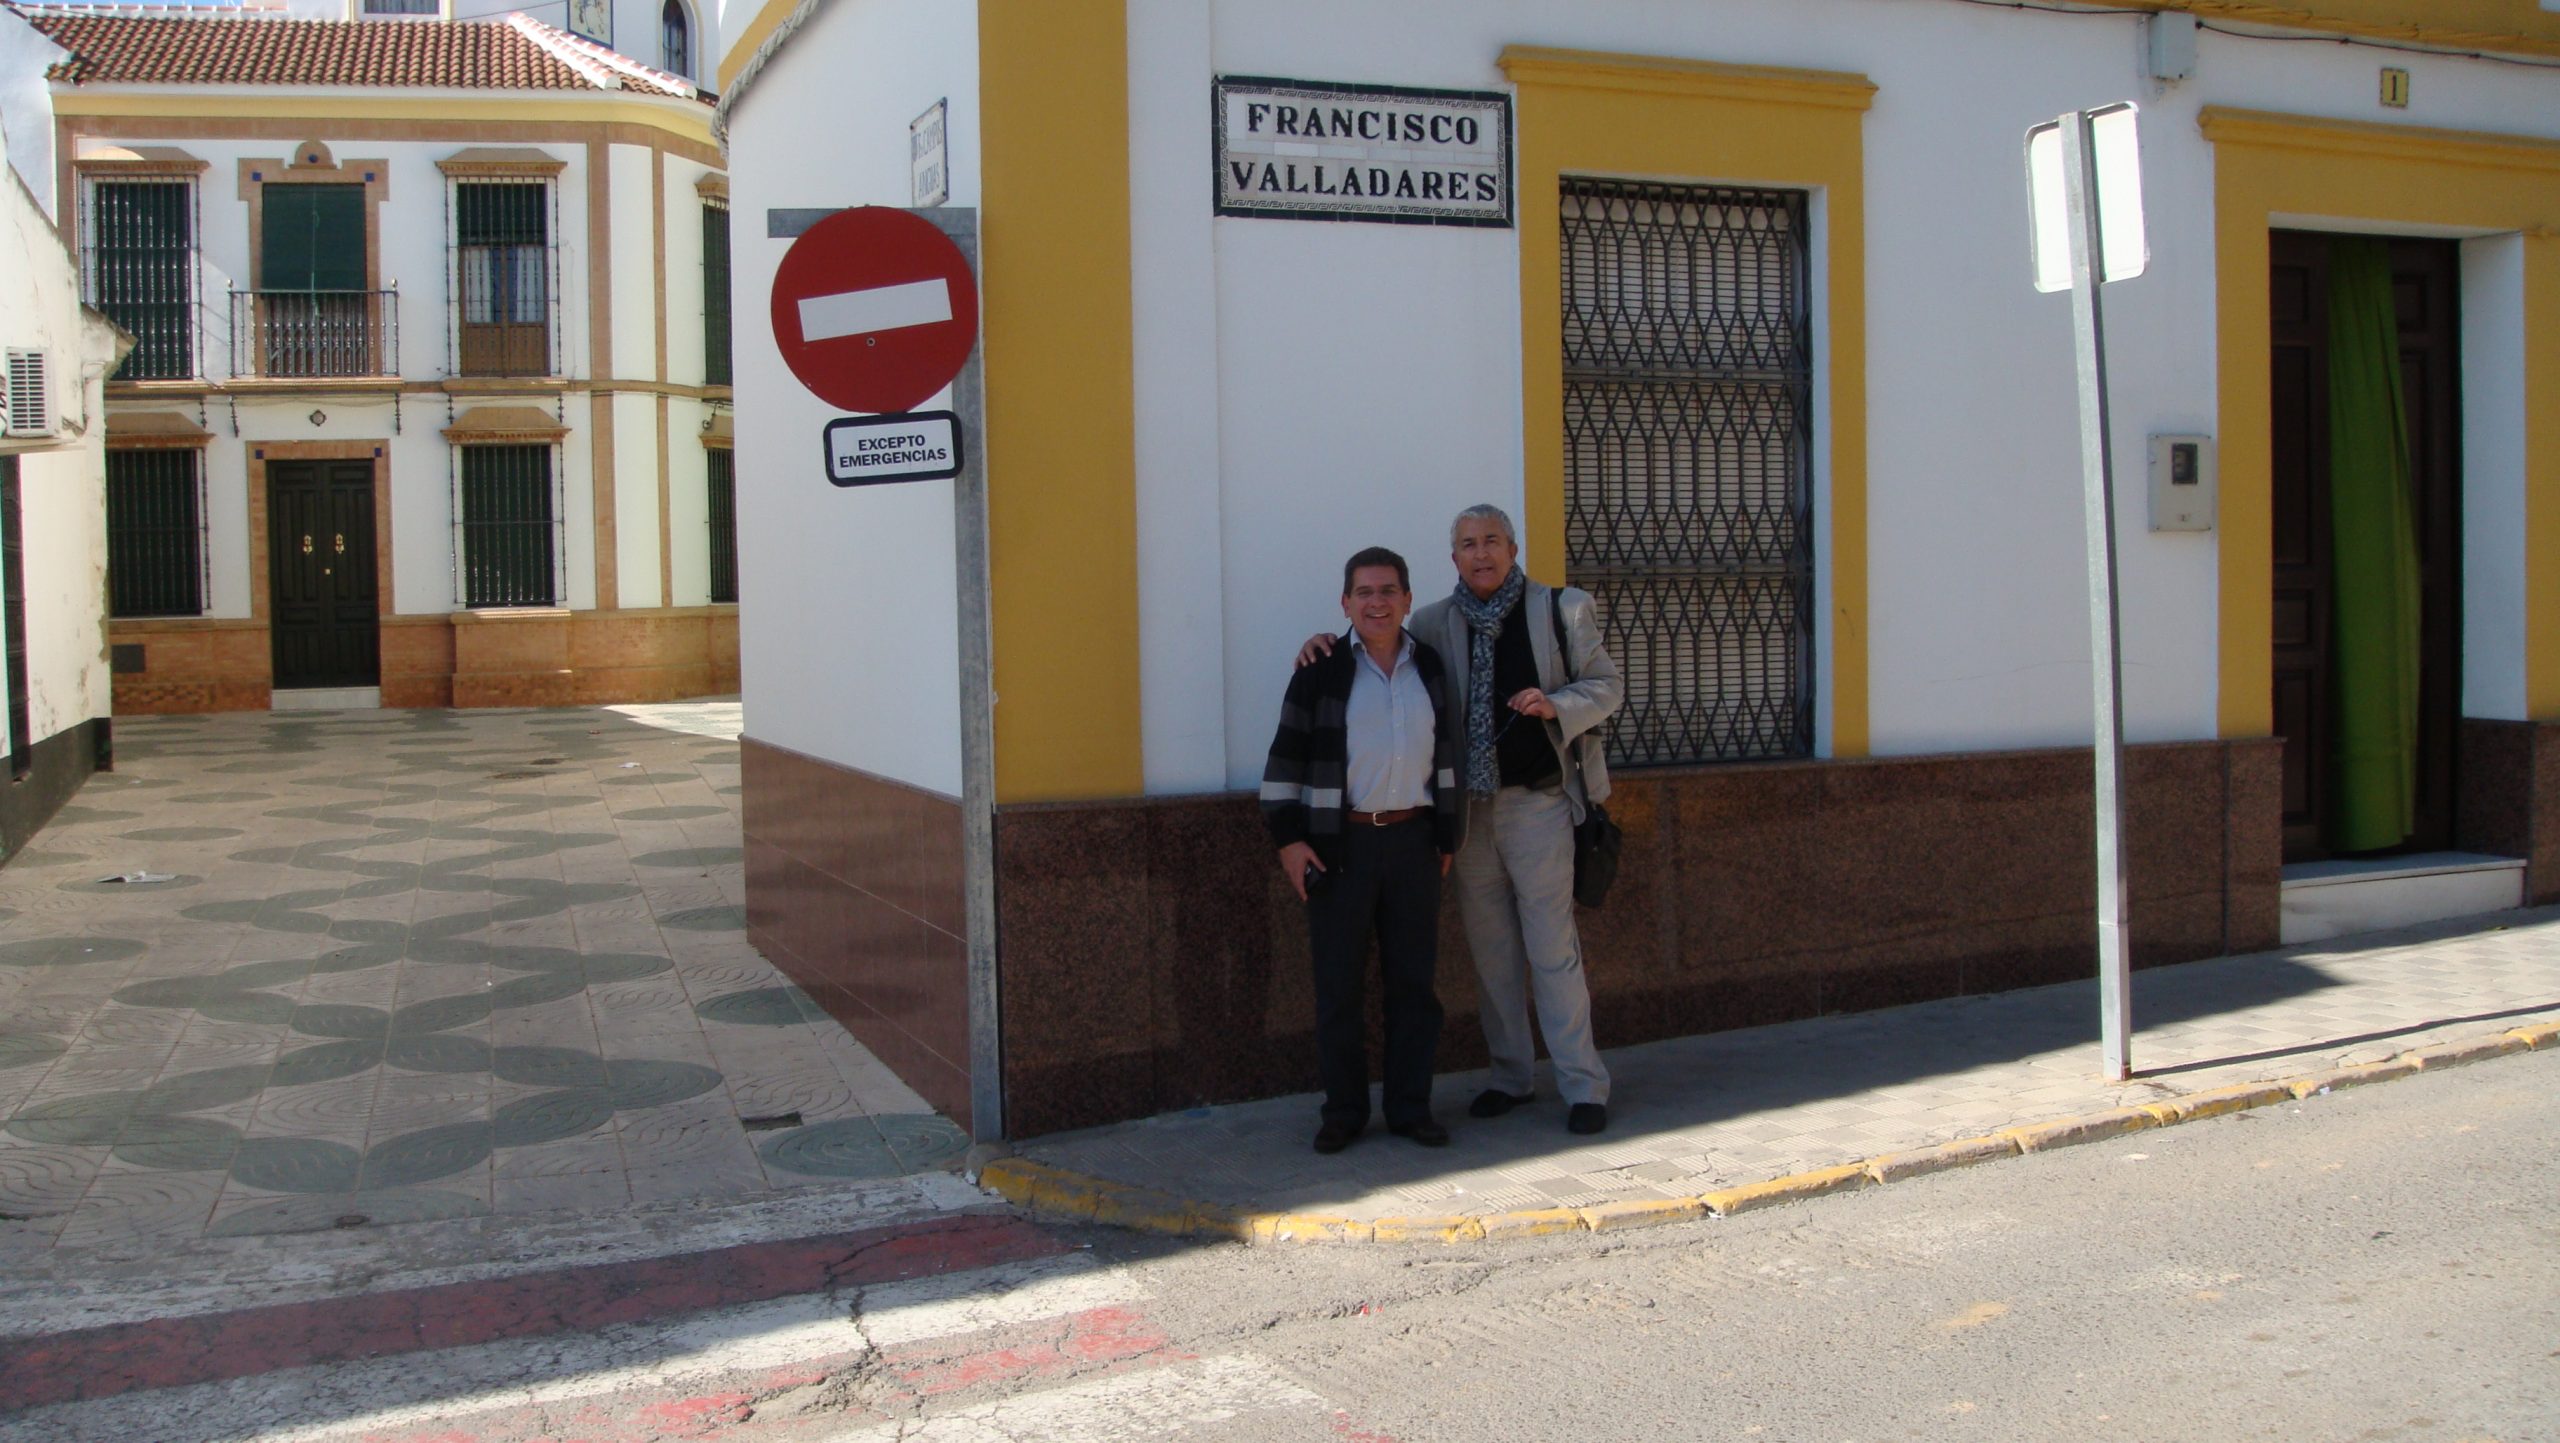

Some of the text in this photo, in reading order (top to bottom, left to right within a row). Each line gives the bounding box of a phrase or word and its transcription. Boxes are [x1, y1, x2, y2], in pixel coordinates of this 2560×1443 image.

[1247, 103, 1479, 145] FRANCISCO
[1229, 161, 1497, 201] VALLADARES
[858, 434, 925, 451] EXCEPTO
[840, 448, 947, 468] EMERGENCIAS
